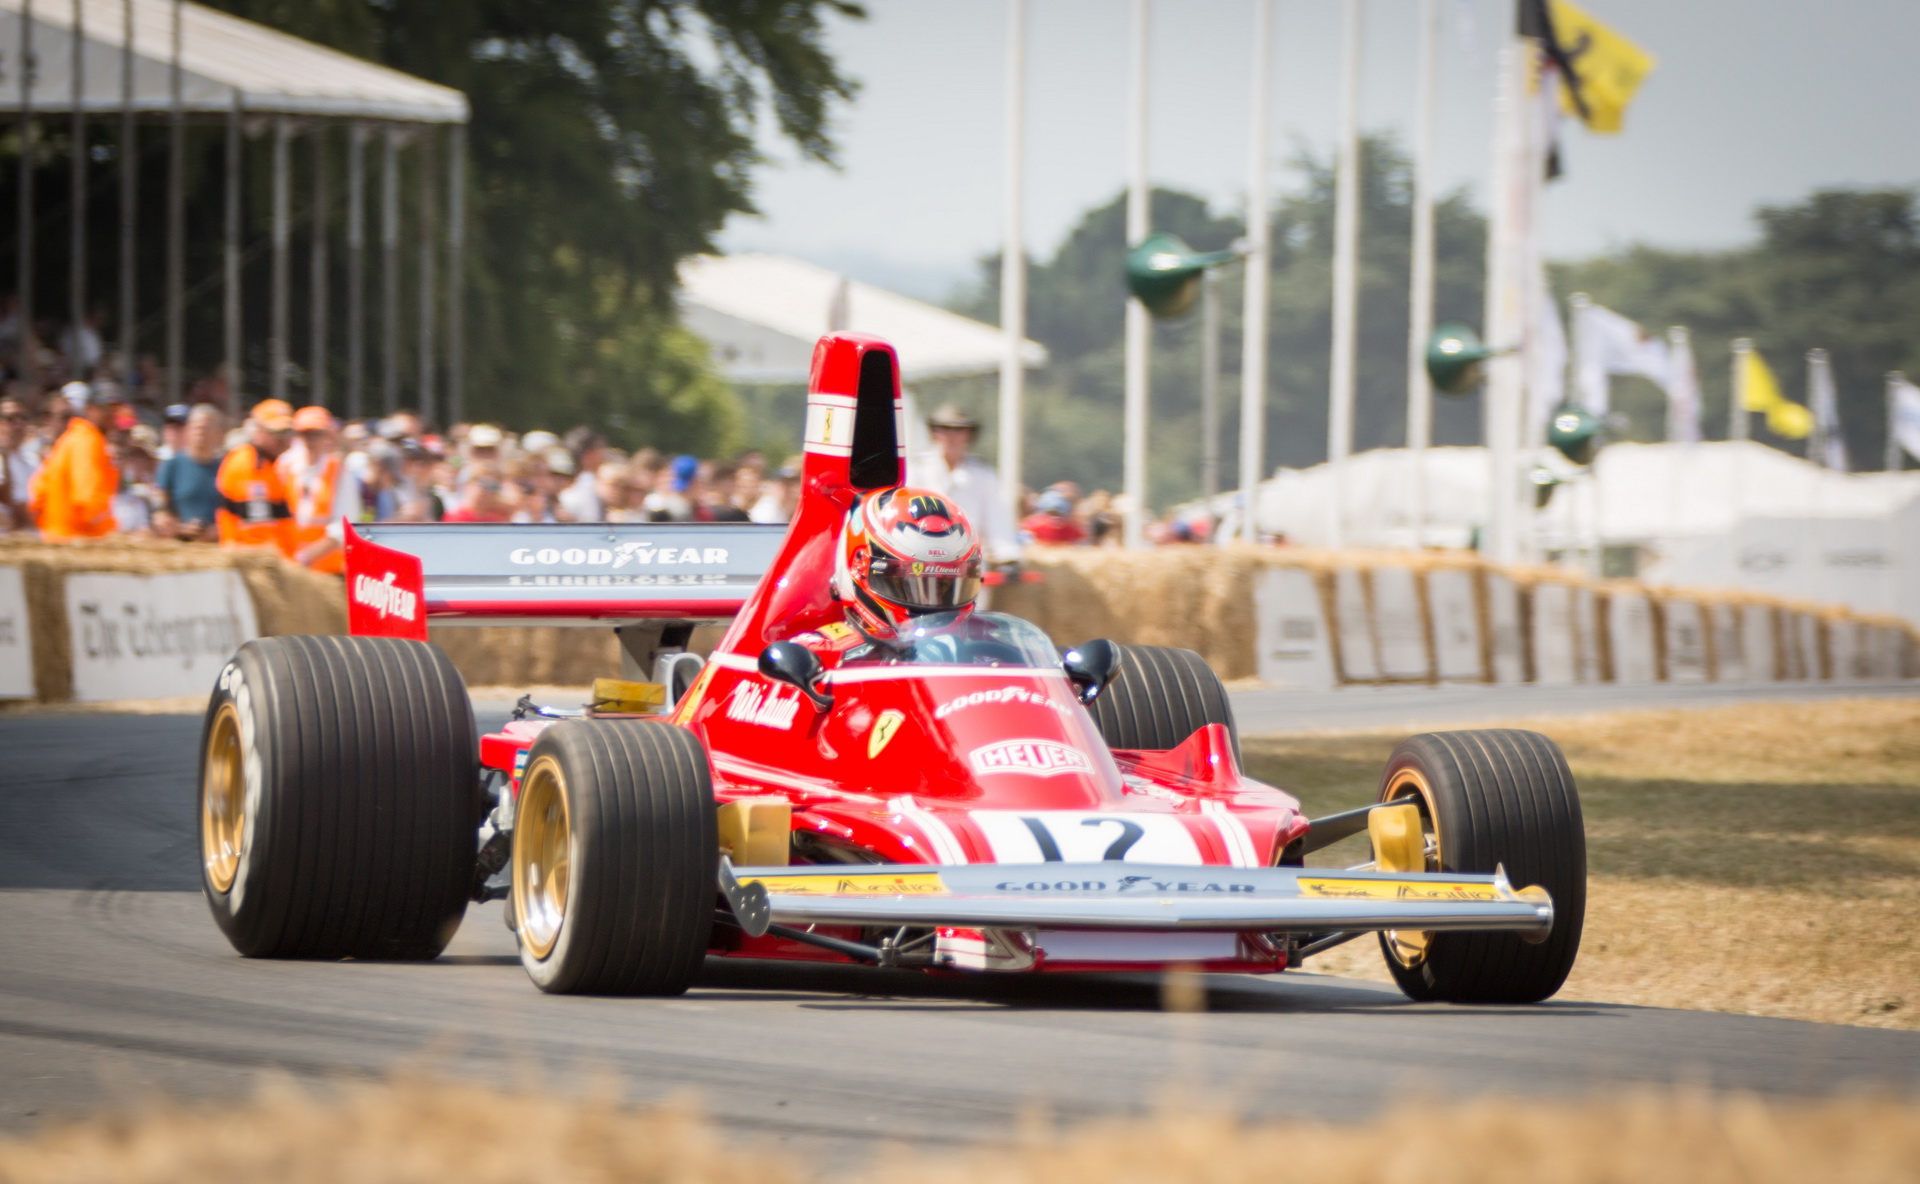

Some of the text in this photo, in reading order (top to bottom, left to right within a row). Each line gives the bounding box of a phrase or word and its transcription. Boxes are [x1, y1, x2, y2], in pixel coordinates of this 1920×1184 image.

[935, 686, 1073, 718] GOODYEAR
[983, 743, 1084, 769] HEUER
[1018, 817, 1145, 862] 12
